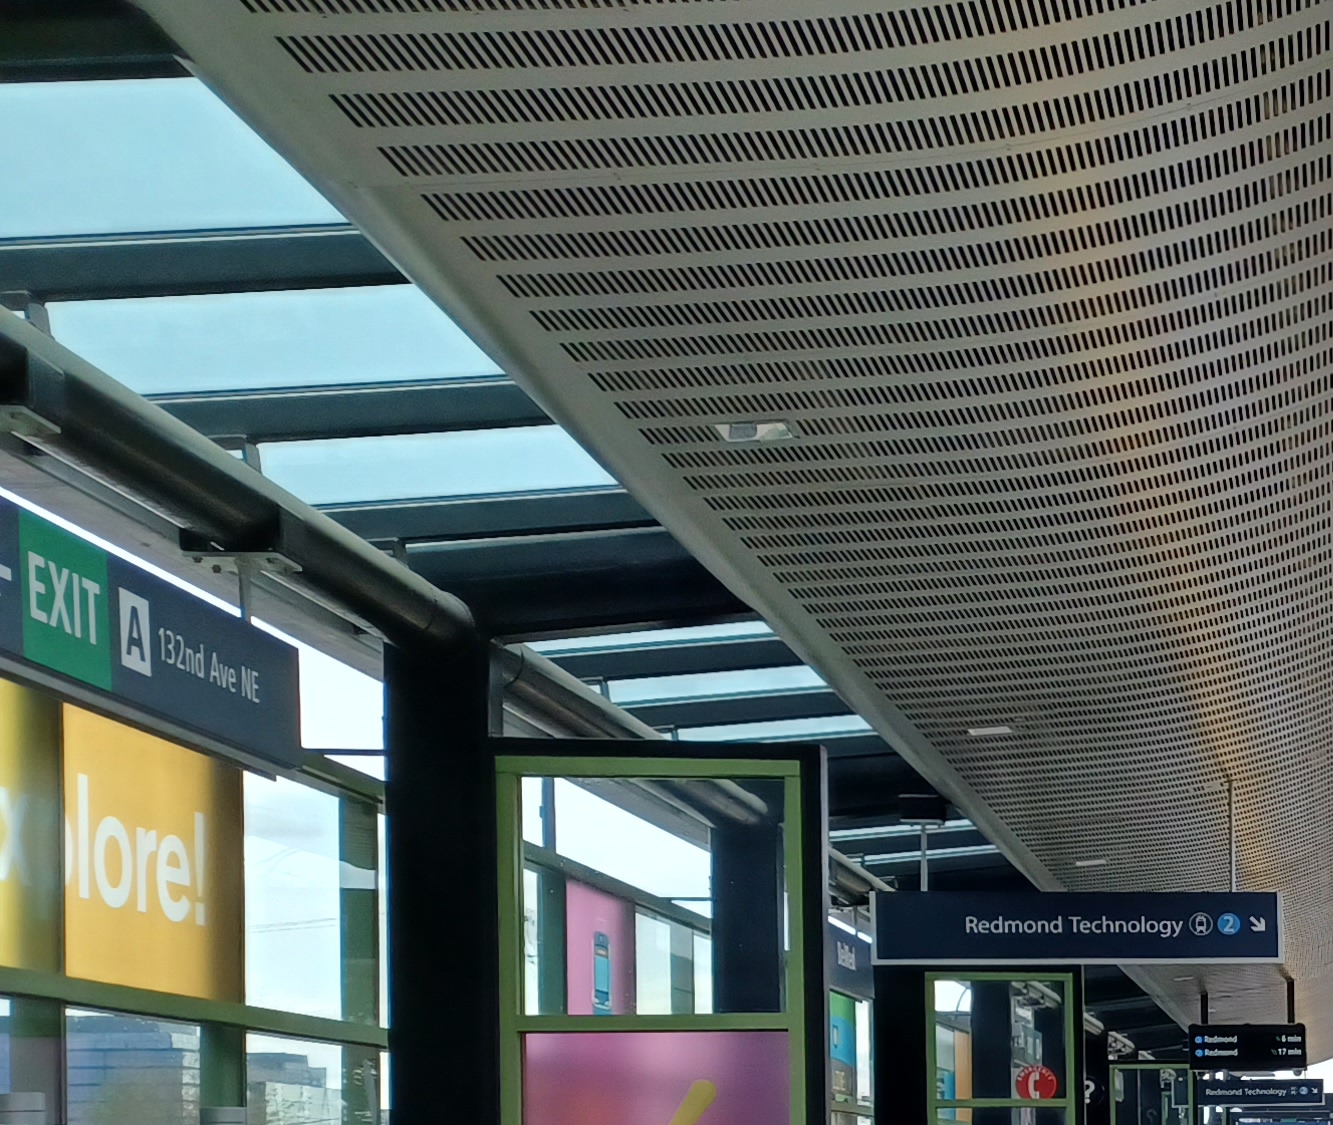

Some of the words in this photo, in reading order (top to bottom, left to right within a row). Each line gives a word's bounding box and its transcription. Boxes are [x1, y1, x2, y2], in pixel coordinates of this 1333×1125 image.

[27, 550, 101, 645] EXIT
[125, 604, 147, 664] A
[158, 627, 205, 679] 132nd
[209, 651, 237, 693] Ave
[241, 666, 260, 703] NE
[965, 915, 1063, 934] Redmond
[1068, 915, 1183, 938] Technology
[1278, 1048, 1287, 1056] 17
[1205, 1087, 1242, 1096] Redmond
[1244, 1087, 1287, 1098] Technology
